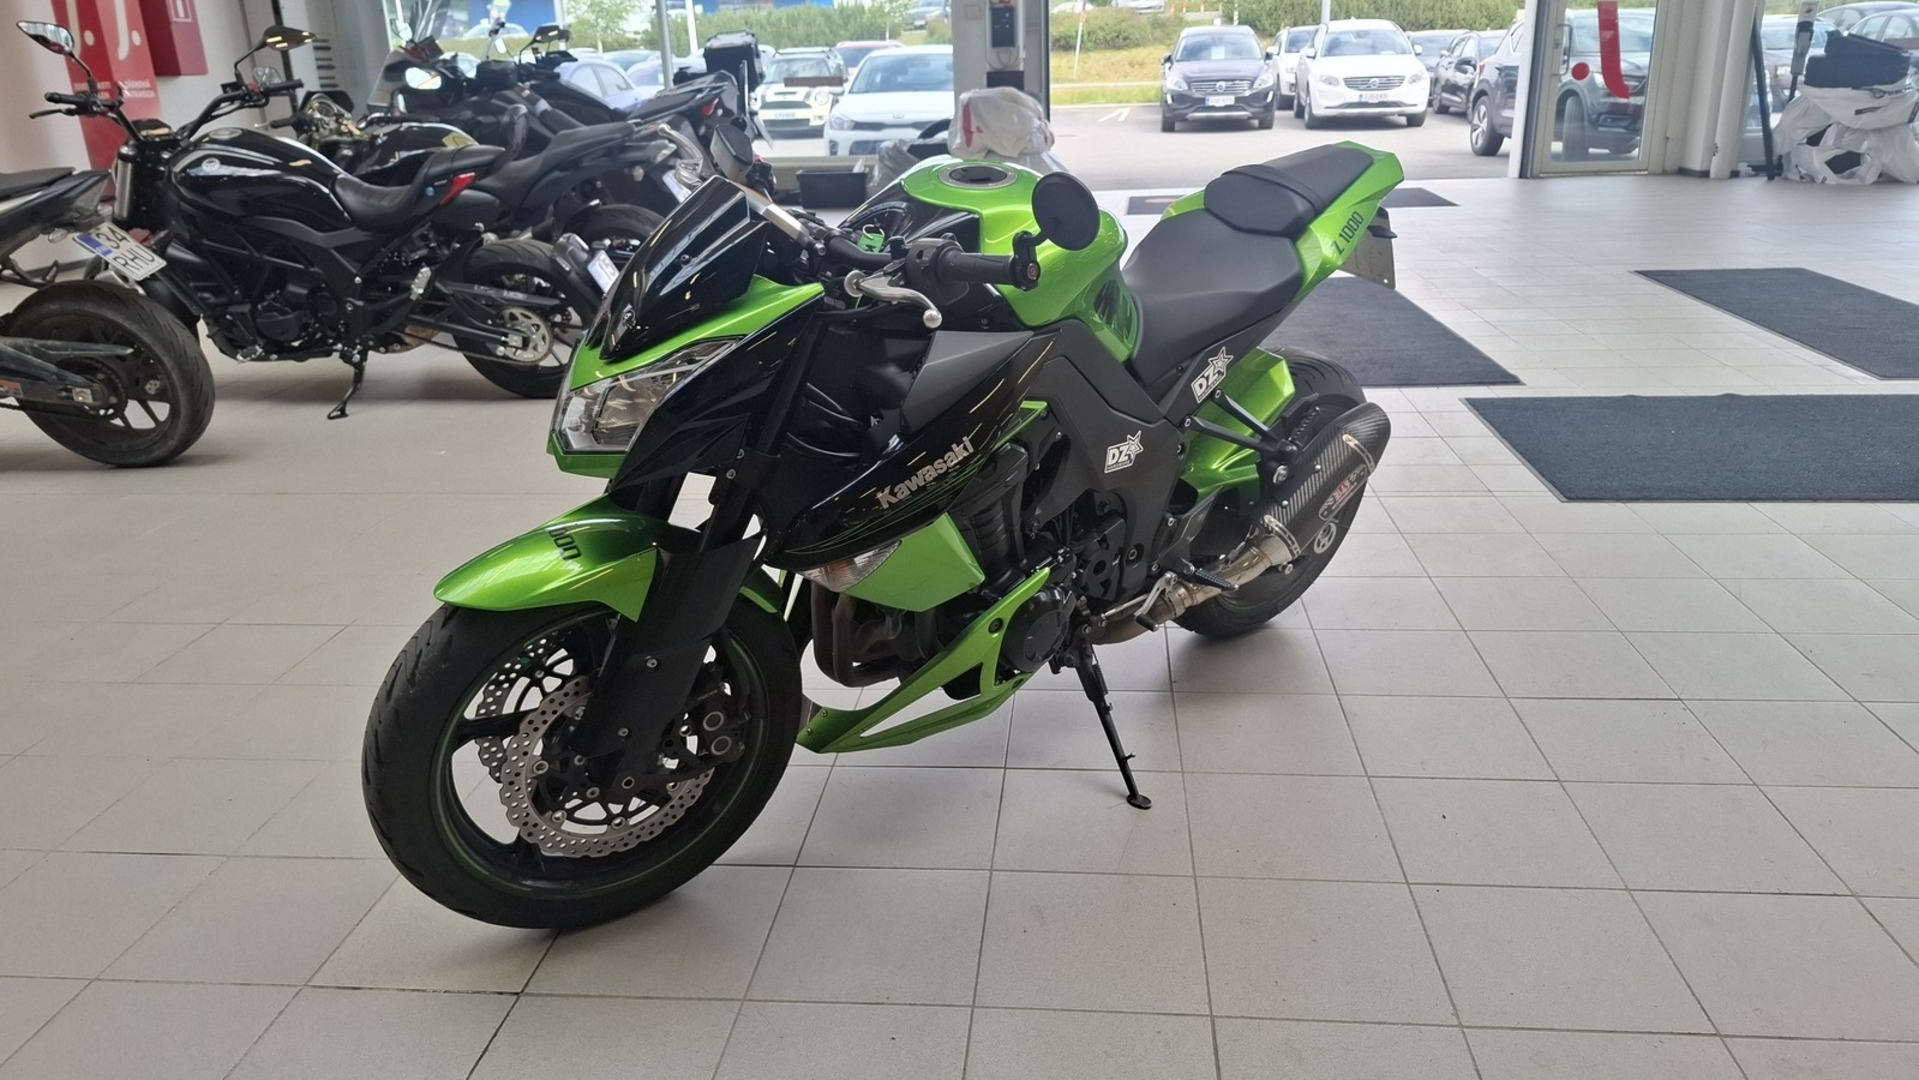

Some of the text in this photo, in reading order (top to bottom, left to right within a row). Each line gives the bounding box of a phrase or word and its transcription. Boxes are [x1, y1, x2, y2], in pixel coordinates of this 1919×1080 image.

[95, 226, 131, 250] 34
[1331, 211, 1364, 256] Z 1000
[112, 244, 156, 274] RHU
[1193, 365, 1219, 397] DZ
[1108, 445, 1130, 466] DZ
[875, 436, 974, 509] Kawasaki
